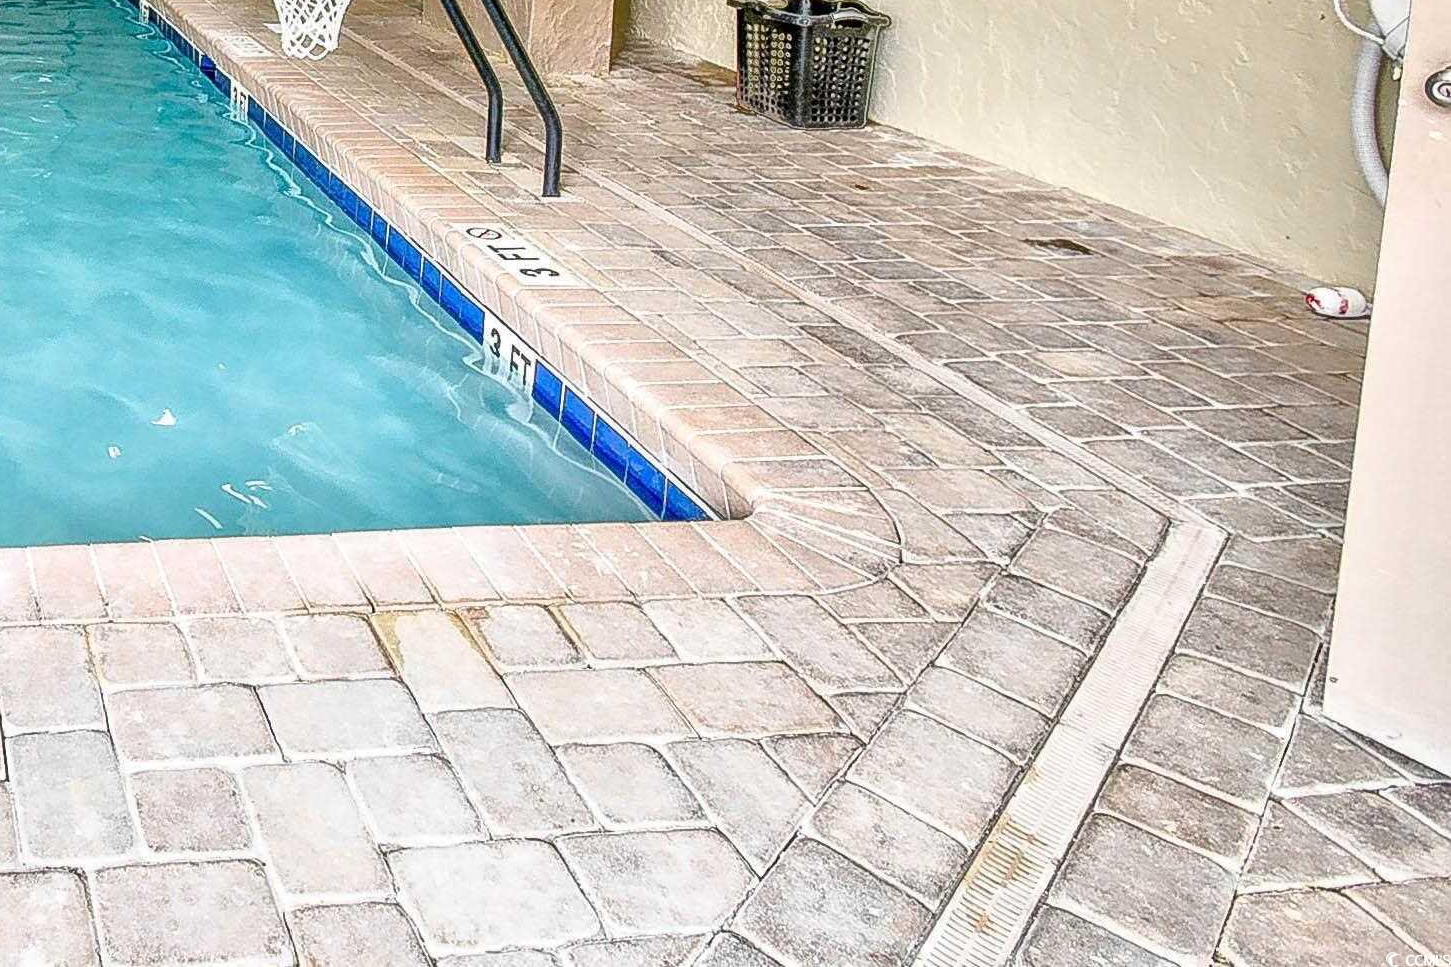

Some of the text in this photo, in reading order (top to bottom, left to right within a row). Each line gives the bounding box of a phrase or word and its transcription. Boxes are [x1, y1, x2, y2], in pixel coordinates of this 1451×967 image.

[487, 244, 560, 278] 3 FT
[490, 327, 531, 386] 3 FT
